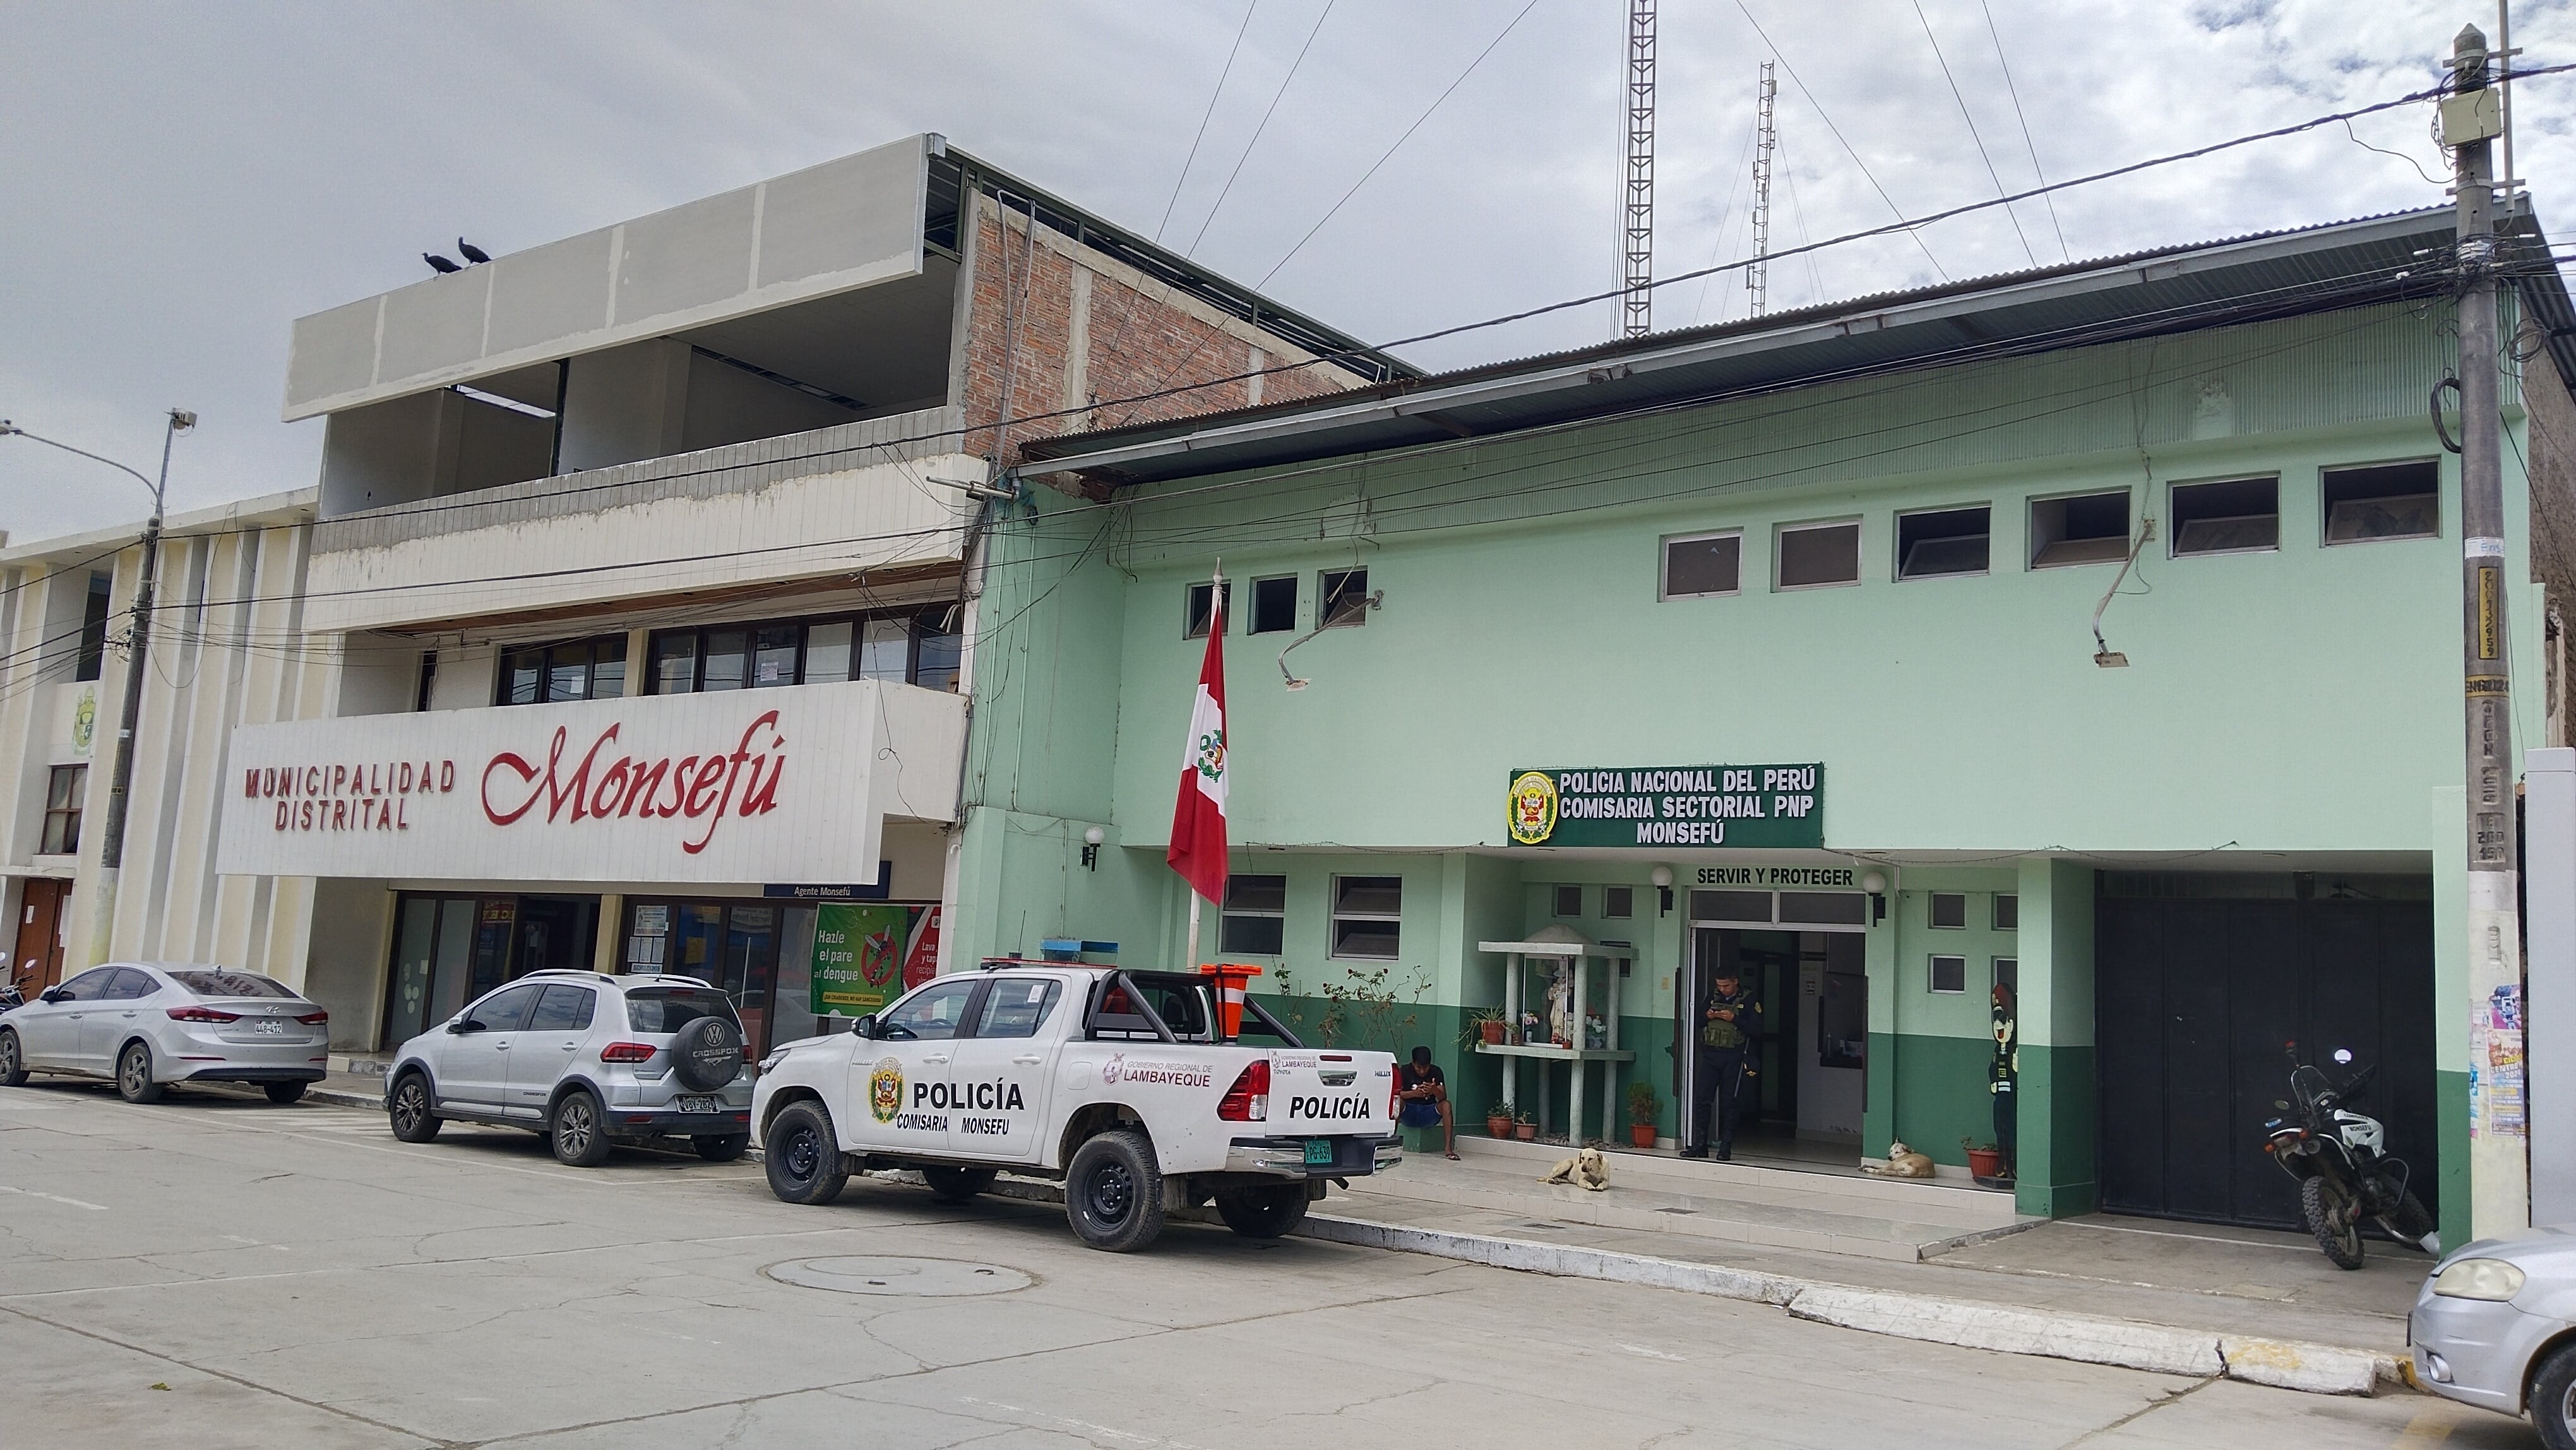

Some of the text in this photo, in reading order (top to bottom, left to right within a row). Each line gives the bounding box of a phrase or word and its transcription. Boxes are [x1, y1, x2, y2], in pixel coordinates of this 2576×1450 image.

[245, 760, 456, 798] MUNICIPALIDAD
[481, 710, 786, 854] Monsefú
[1559, 765, 1816, 794] POLICIA NACIONAL DEL PERÚ
[275, 798, 409, 831] DISTRITAL
[1560, 795, 1815, 819] COMISARIA SECTORIAL PNP
[1637, 819, 1724, 844] MONSEFÚ
[1697, 868, 1854, 885] SERVIR Y PROTEGER
[794, 885, 850, 897] Agente Monsefú
[818, 930, 845, 944] Hazle
[819, 947, 853, 964] el pare
[921, 955, 926, 964] y
[814, 966, 859, 984] al dengue
[692, 1047, 739, 1058] CROSSFOX
[1127, 1061, 1213, 1073] GOBIERNO REGIONAL DE
[1124, 1069, 1211, 1088] LAMBAYEQUE
[914, 1077, 1025, 1110] POLICÍA
[1289, 1093, 1370, 1119] POLICÍA
[897, 1113, 1010, 1135] COMISARIA MONSEFU
